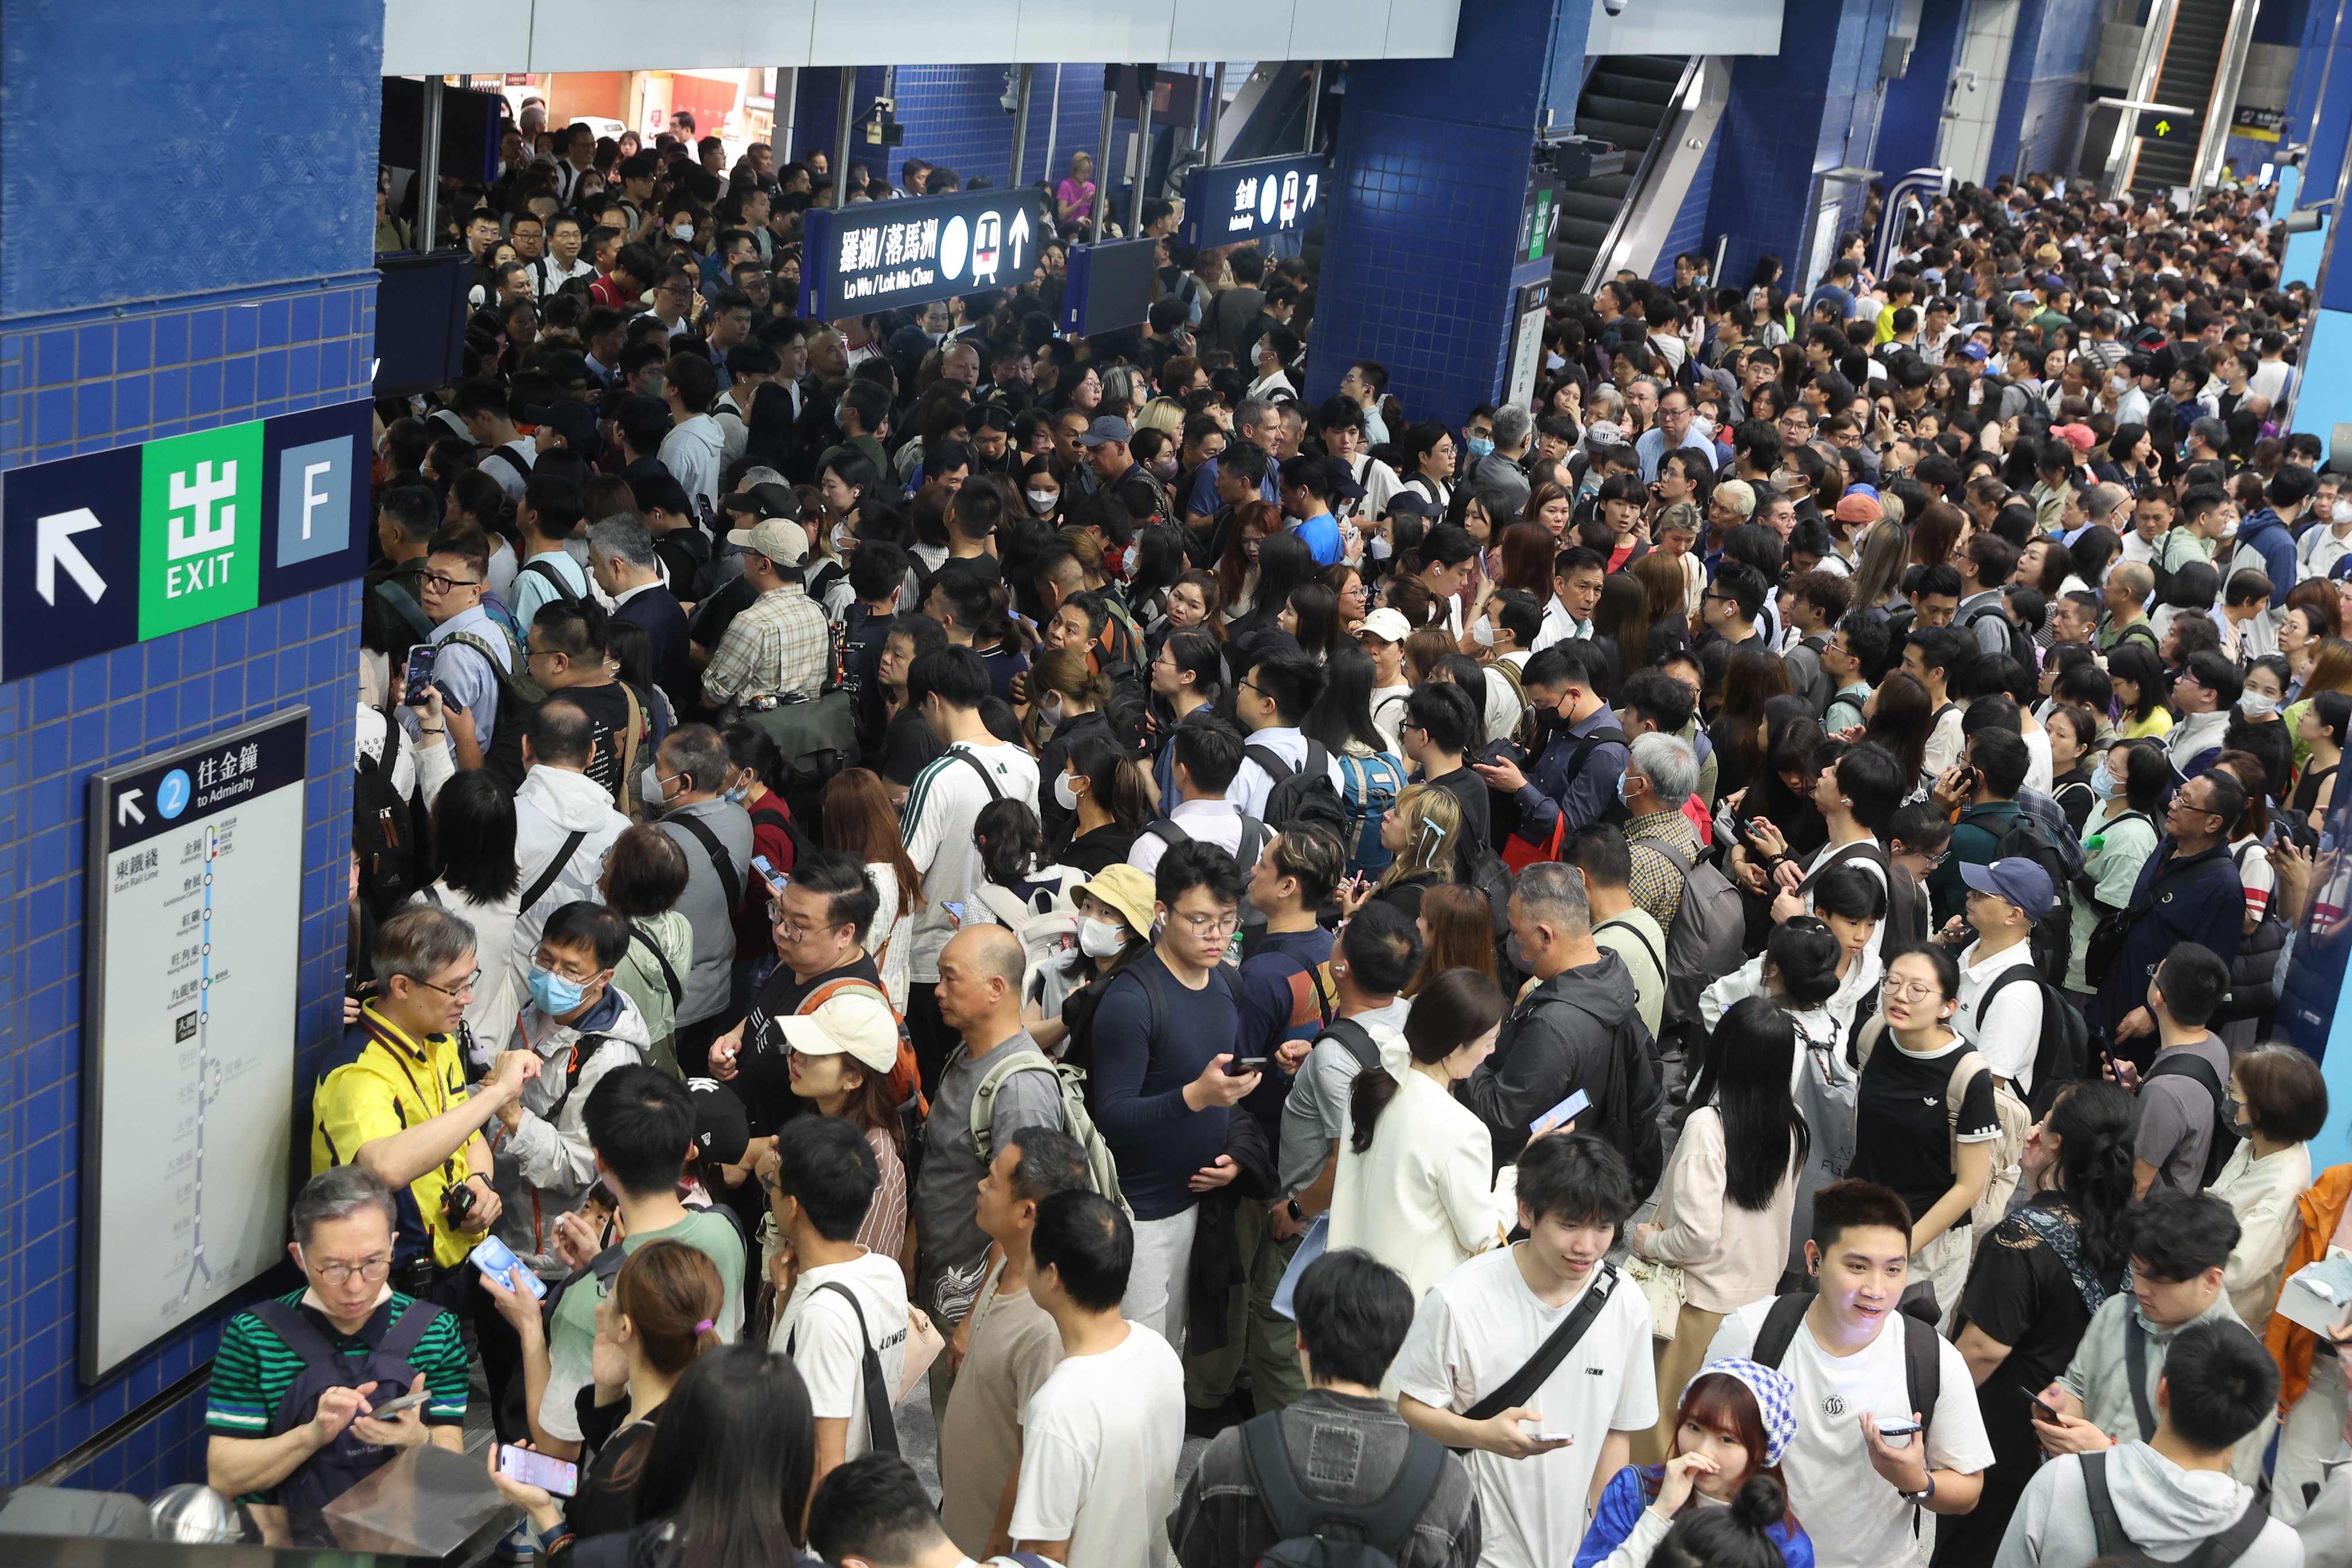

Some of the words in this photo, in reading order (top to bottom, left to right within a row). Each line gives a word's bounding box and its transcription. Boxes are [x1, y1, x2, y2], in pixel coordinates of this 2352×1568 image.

[1523, 213, 1531, 243] F
[1535, 200, 1548, 234] 出
[1533, 234, 1543, 248] EXIT
[844, 280, 856, 299] Lo
[857, 276, 872, 297] Wu
[879, 271, 896, 293] Lok
[896, 271, 910, 289] Ma
[911, 267, 934, 287] Chau
[1594, 431, 1613, 442] HELLO!
[167, 460, 238, 561] 出
[302, 461, 331, 540] F
[167, 551, 234, 599] EXIT
[198, 743, 258, 790] 往金鐘
[167, 778, 181, 811] 2
[198, 796, 208, 808] to
[209, 777, 256, 804] Admiralty
[115, 882, 129, 893] East
[144, 870, 159, 881] Line
